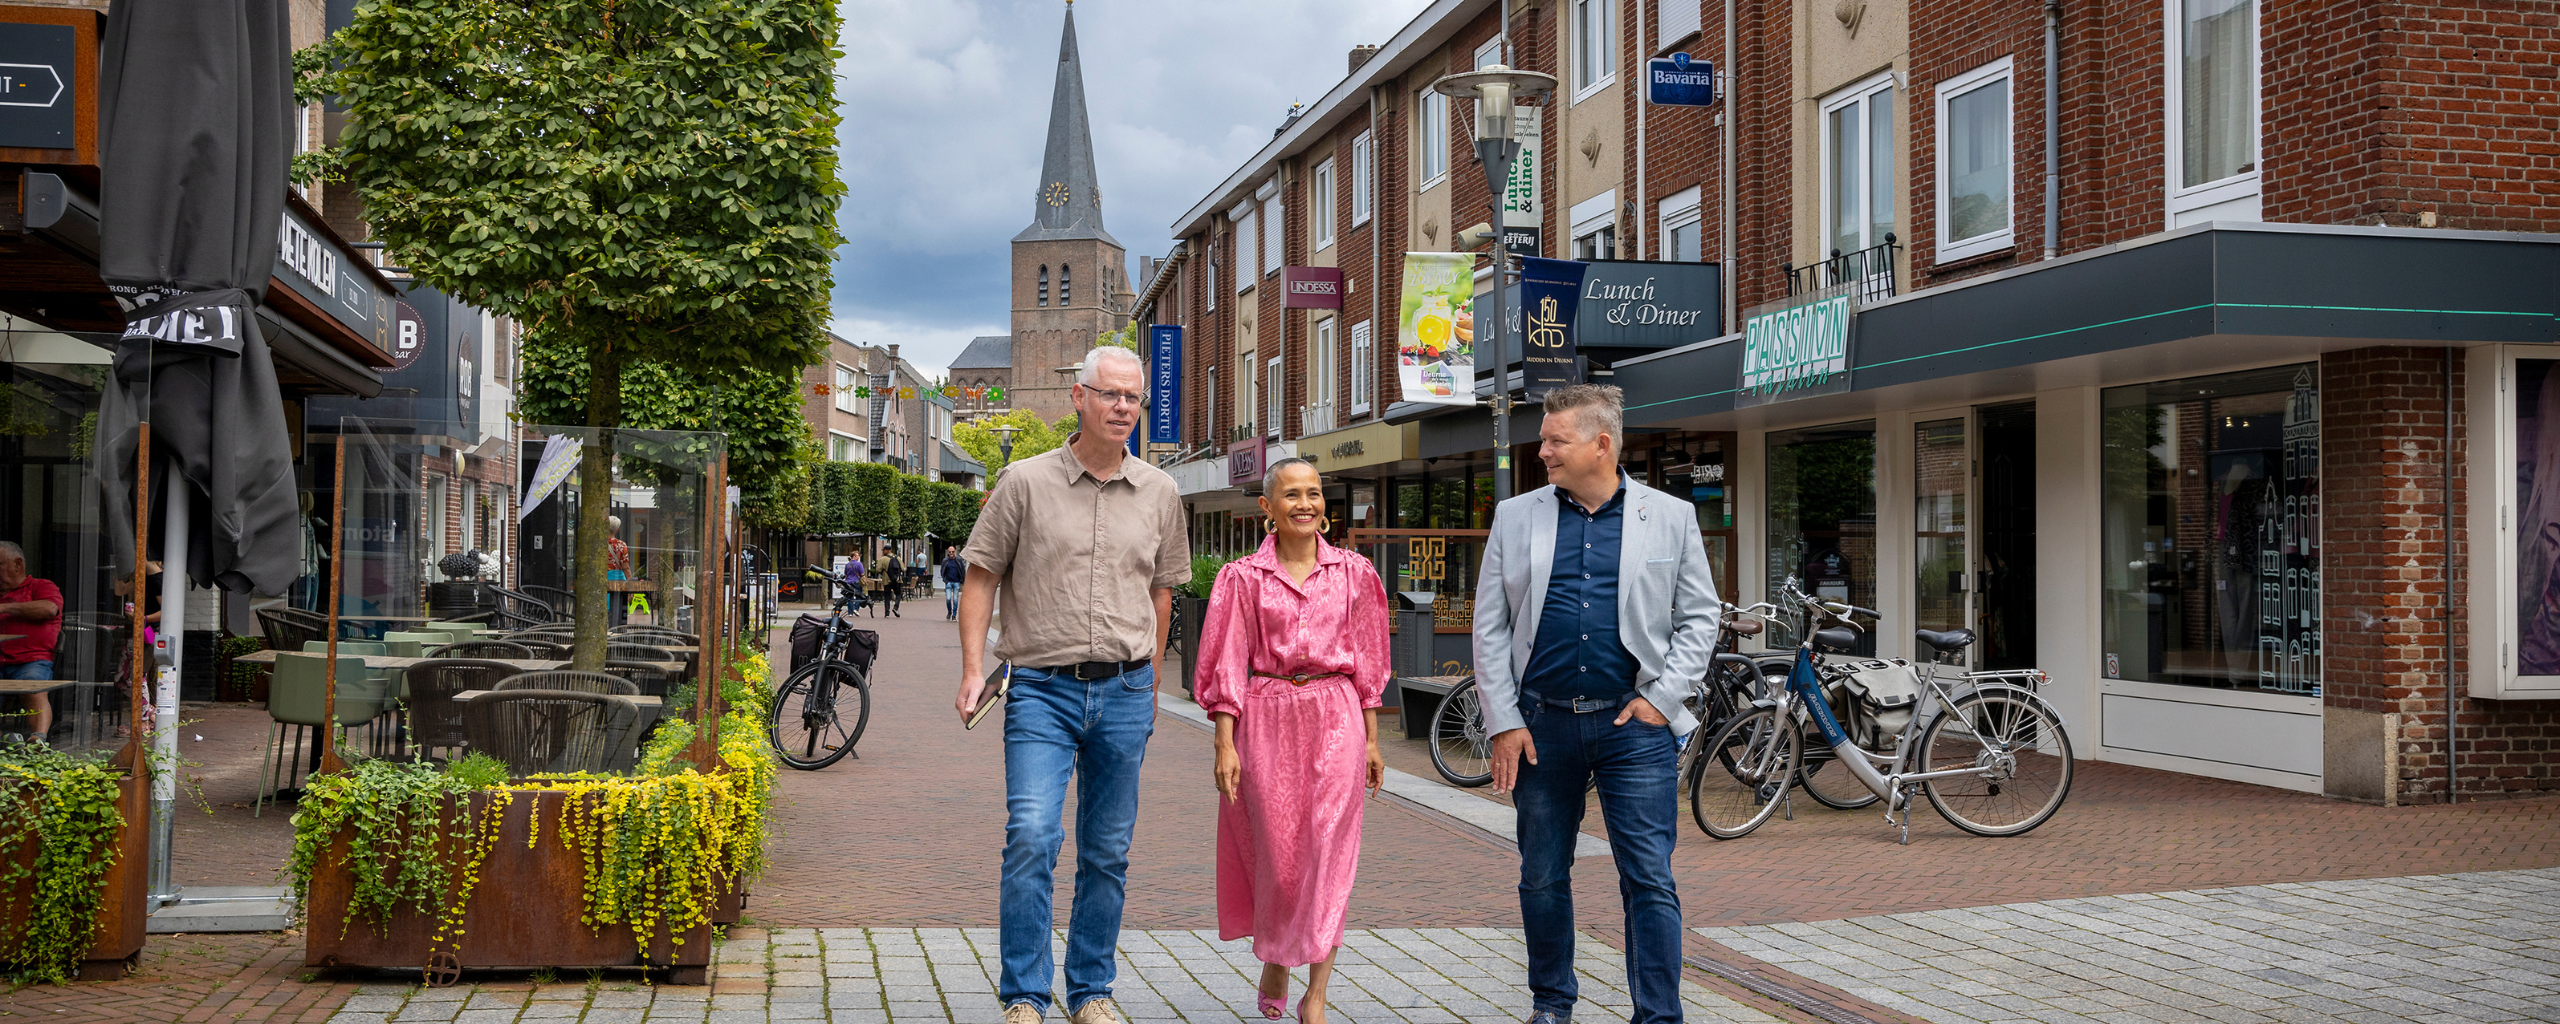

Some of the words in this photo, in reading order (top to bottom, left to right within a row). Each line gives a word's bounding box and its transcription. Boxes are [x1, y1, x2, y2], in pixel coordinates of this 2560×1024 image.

[1654, 70, 1710, 85] Bavaria
[1519, 148, 1532, 199] diner
[1520, 200, 1532, 213] &
[1290, 281, 1337, 293] LINDESSA
[1409, 270, 1462, 287] zomer
[1584, 276, 1655, 301] Lunch
[1606, 301, 1632, 326] &
[1635, 303, 1702, 326] Diner
[1161, 333, 1171, 387] PIETERS
[1423, 370, 1447, 378] Deurne
